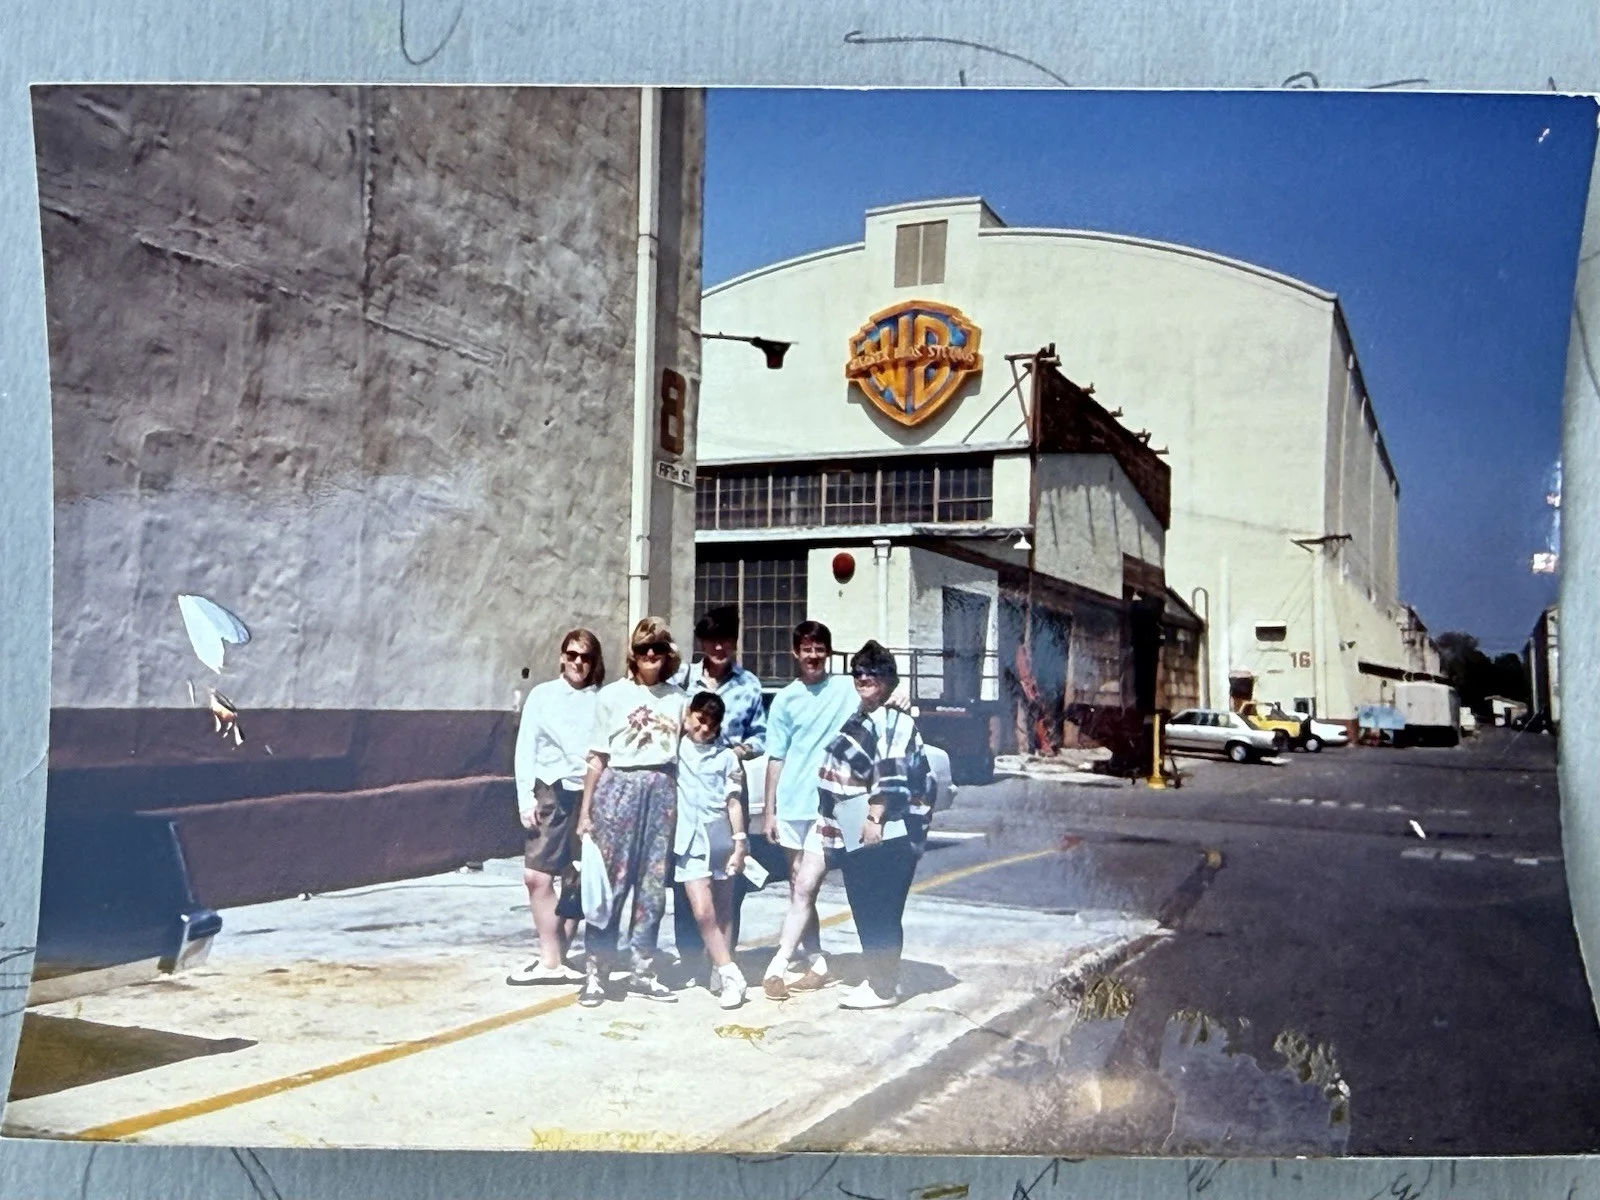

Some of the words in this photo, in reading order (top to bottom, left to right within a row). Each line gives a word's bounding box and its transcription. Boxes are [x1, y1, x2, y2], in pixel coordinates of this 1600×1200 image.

[861, 314, 951, 411] WB
[660, 367, 687, 456] 8
[1290, 651, 1311, 668] 16
